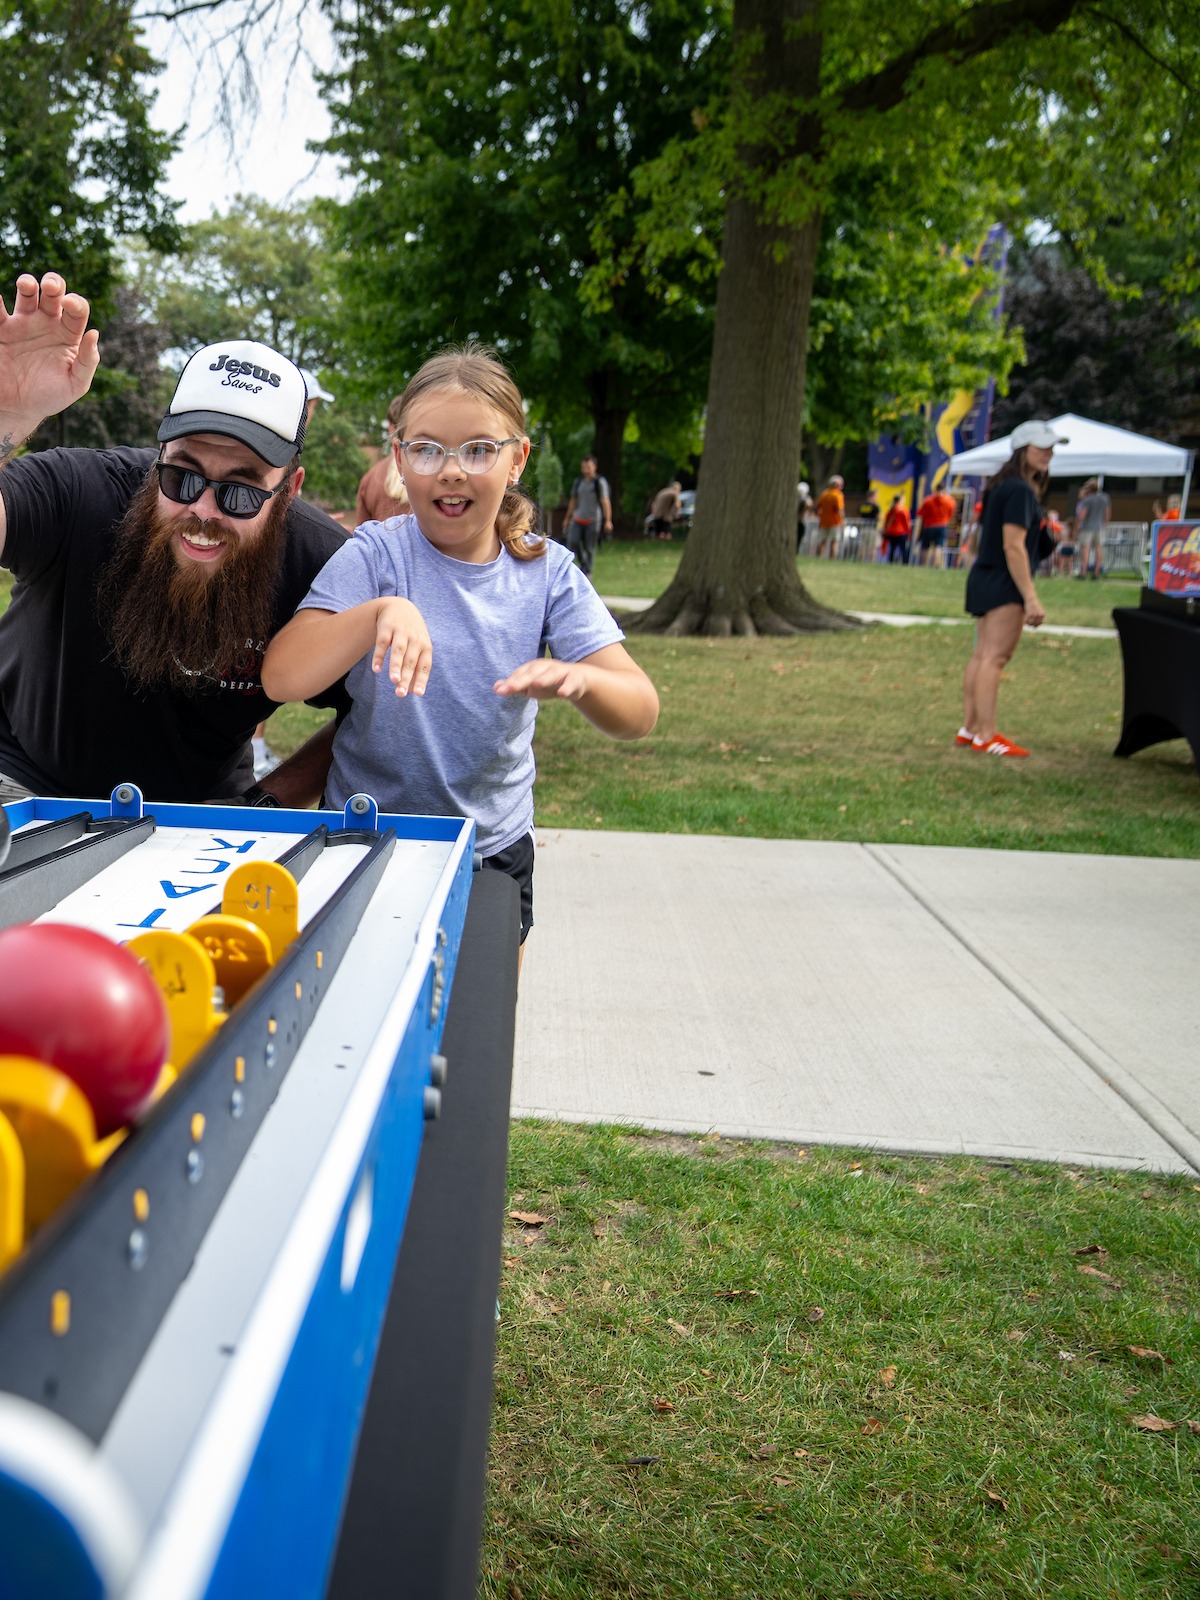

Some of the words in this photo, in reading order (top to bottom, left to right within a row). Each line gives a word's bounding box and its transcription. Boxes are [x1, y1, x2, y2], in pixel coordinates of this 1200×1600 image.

[209, 354, 282, 388] Jesus
[221, 371, 263, 394] Saves
[219, 680, 254, 690] DEEP
